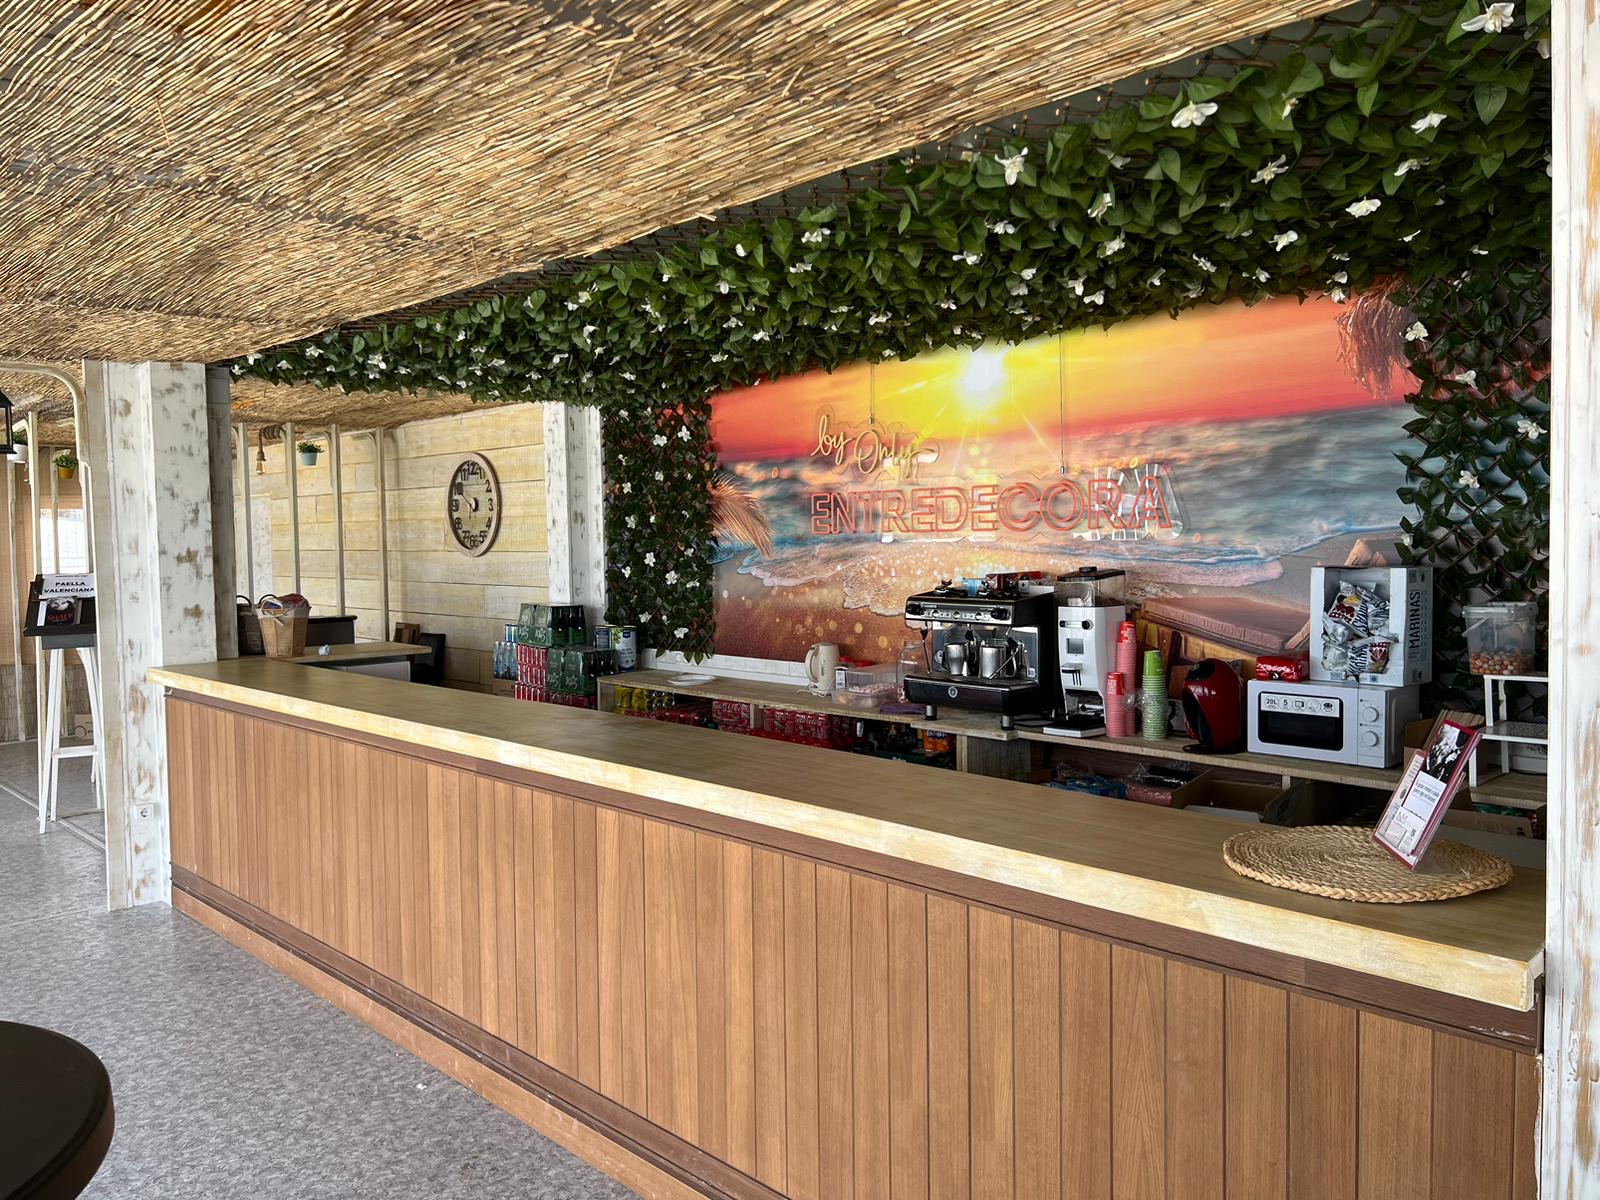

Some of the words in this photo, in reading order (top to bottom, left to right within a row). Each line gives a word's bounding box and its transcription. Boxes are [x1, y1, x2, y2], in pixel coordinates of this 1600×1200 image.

[810, 414, 853, 466] by
[810, 476, 1173, 535] ENTREDECORA
[1409, 591, 1421, 649] MARINAS
